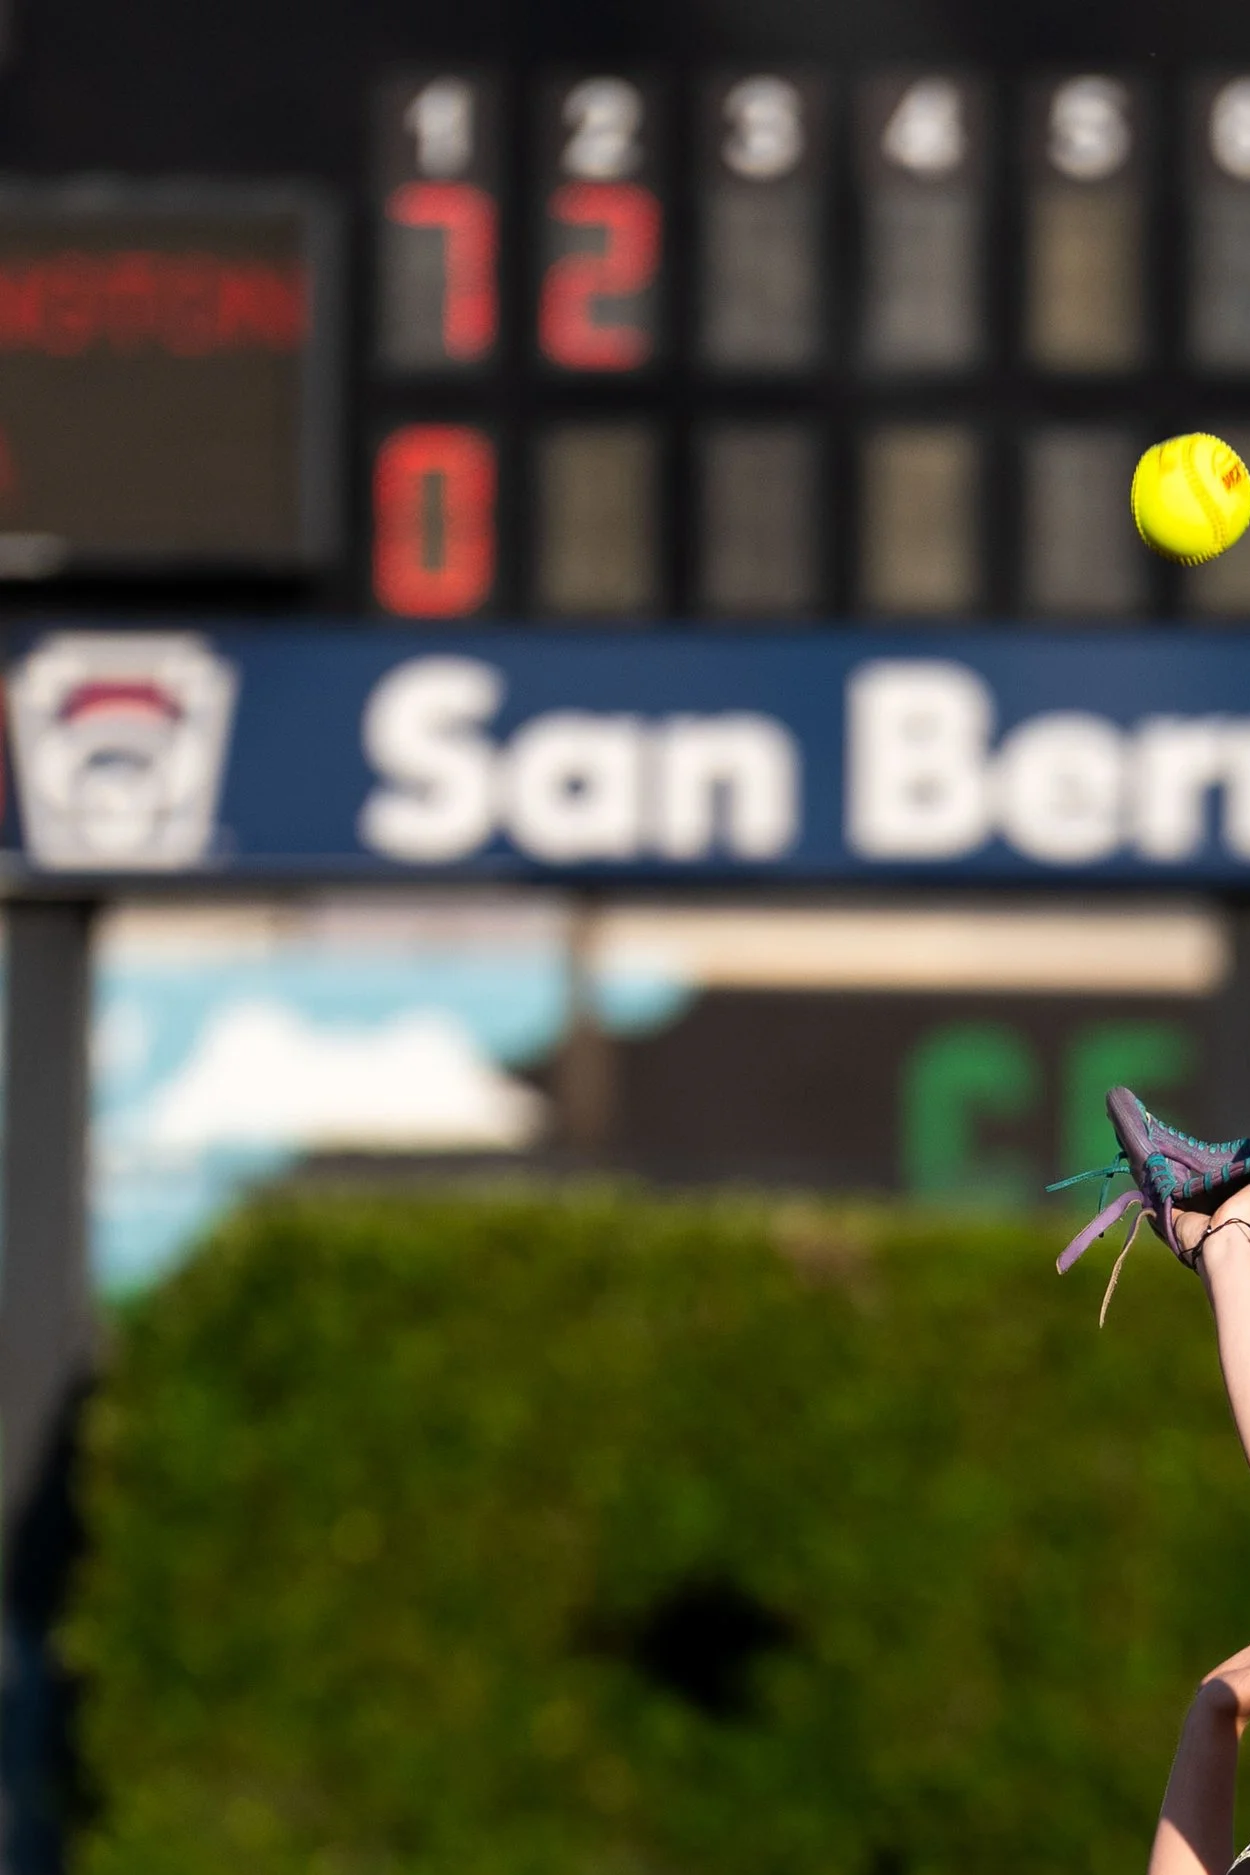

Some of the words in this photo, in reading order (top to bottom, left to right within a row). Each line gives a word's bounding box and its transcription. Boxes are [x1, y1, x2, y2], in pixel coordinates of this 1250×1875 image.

[406, 79, 473, 178] 1
[563, 78, 640, 182] 2
[725, 77, 801, 180] 3
[885, 80, 962, 178] 4
[1050, 76, 1128, 181] 5
[389, 181, 497, 360] 7
[538, 181, 661, 371] 2
[373, 424, 496, 619] 0
[362, 655, 798, 864] San
